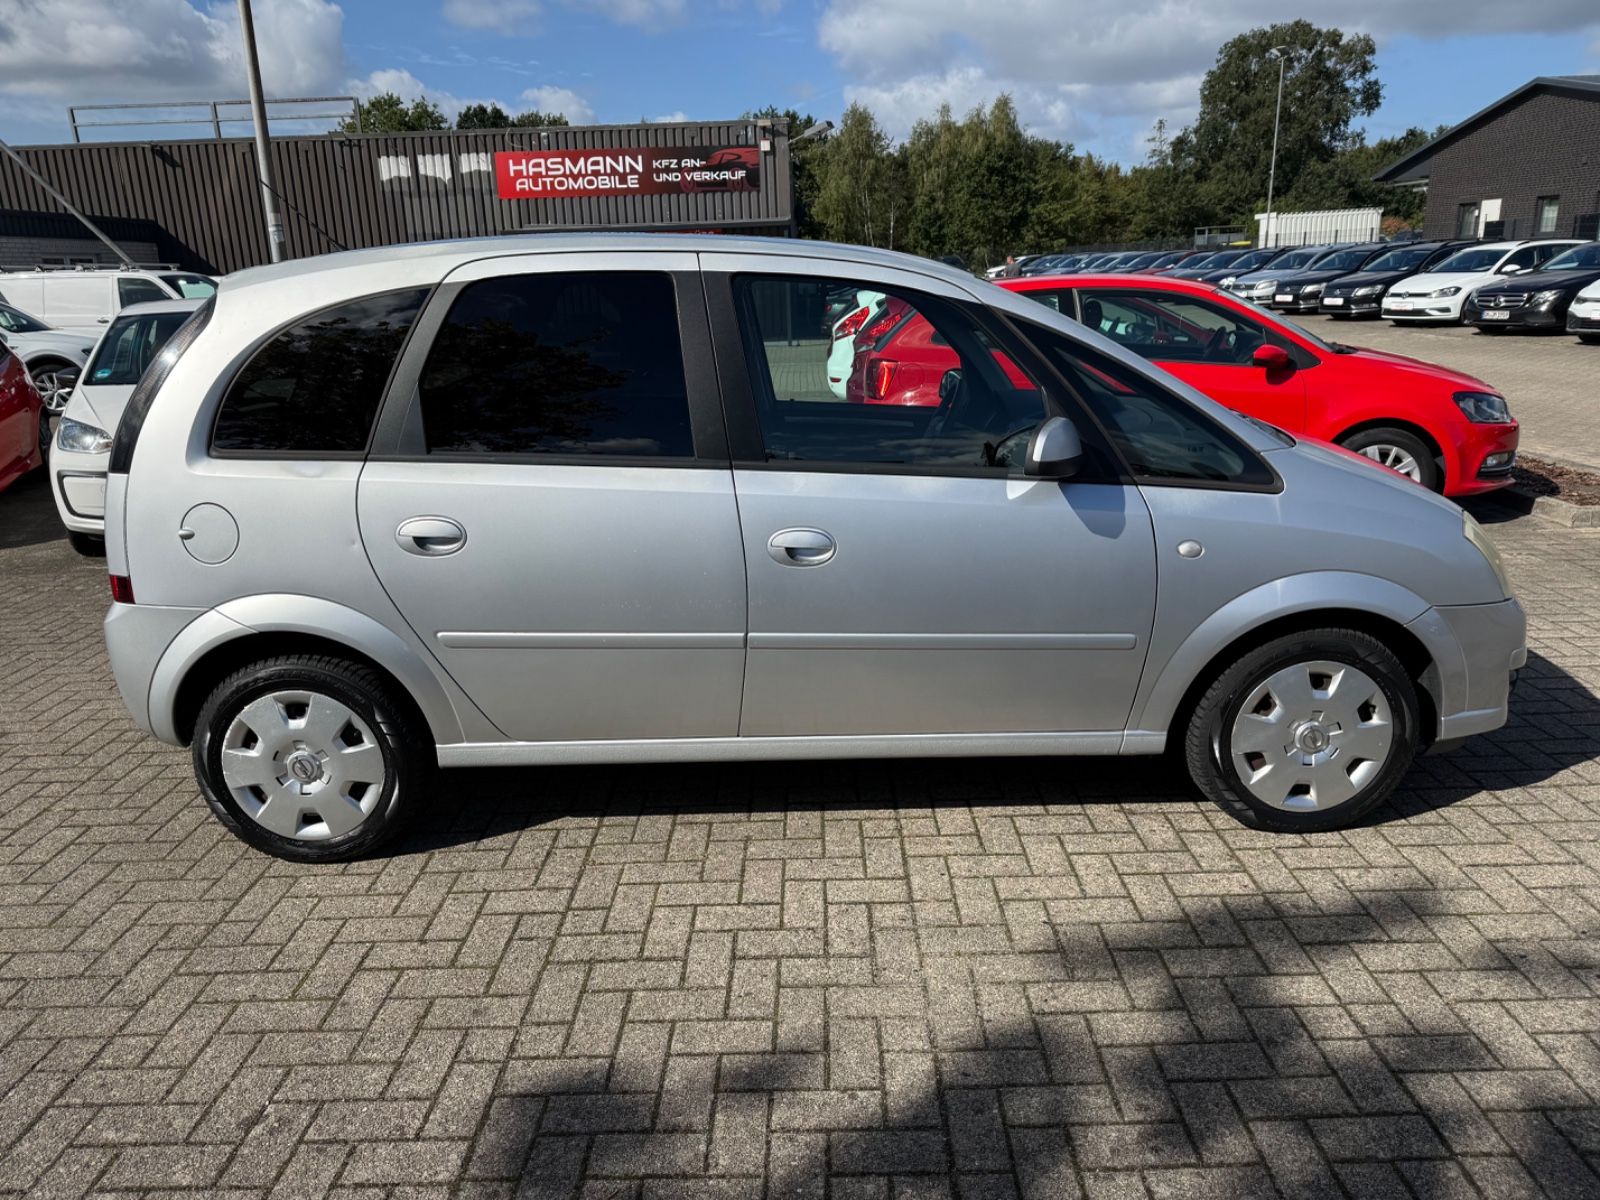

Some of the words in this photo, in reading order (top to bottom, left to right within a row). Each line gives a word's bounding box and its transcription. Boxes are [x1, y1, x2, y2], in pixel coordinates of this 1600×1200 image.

[508, 155, 643, 176] HASMANN
[652, 159, 679, 169] KFZ
[681, 158, 707, 168] AN-
[515, 175, 640, 191] AUTOMOBILE
[653, 172, 681, 182] UND
[684, 170, 747, 181] VERKAUF
